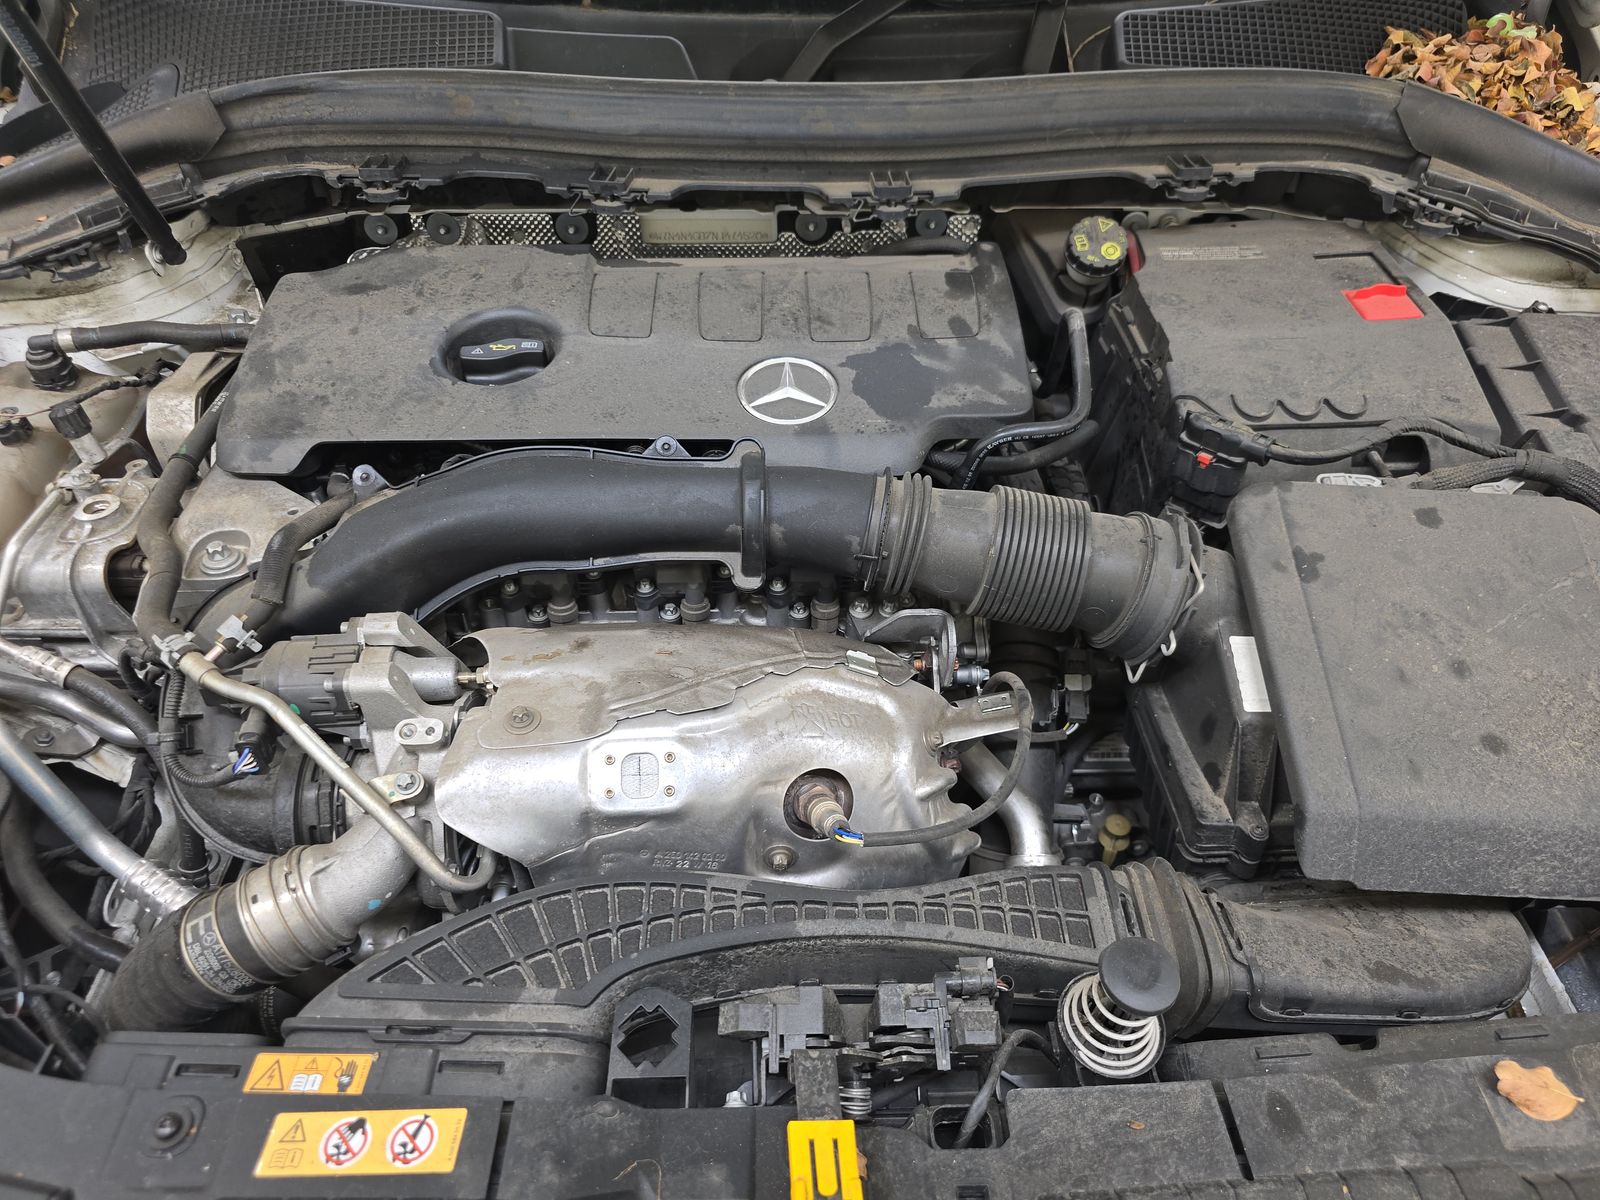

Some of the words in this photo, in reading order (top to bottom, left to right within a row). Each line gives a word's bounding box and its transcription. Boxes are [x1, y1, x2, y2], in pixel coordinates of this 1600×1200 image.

[986, 436, 1012, 450] KAYSER
[827, 711, 862, 728] HOT
[676, 860, 689, 868] 22
